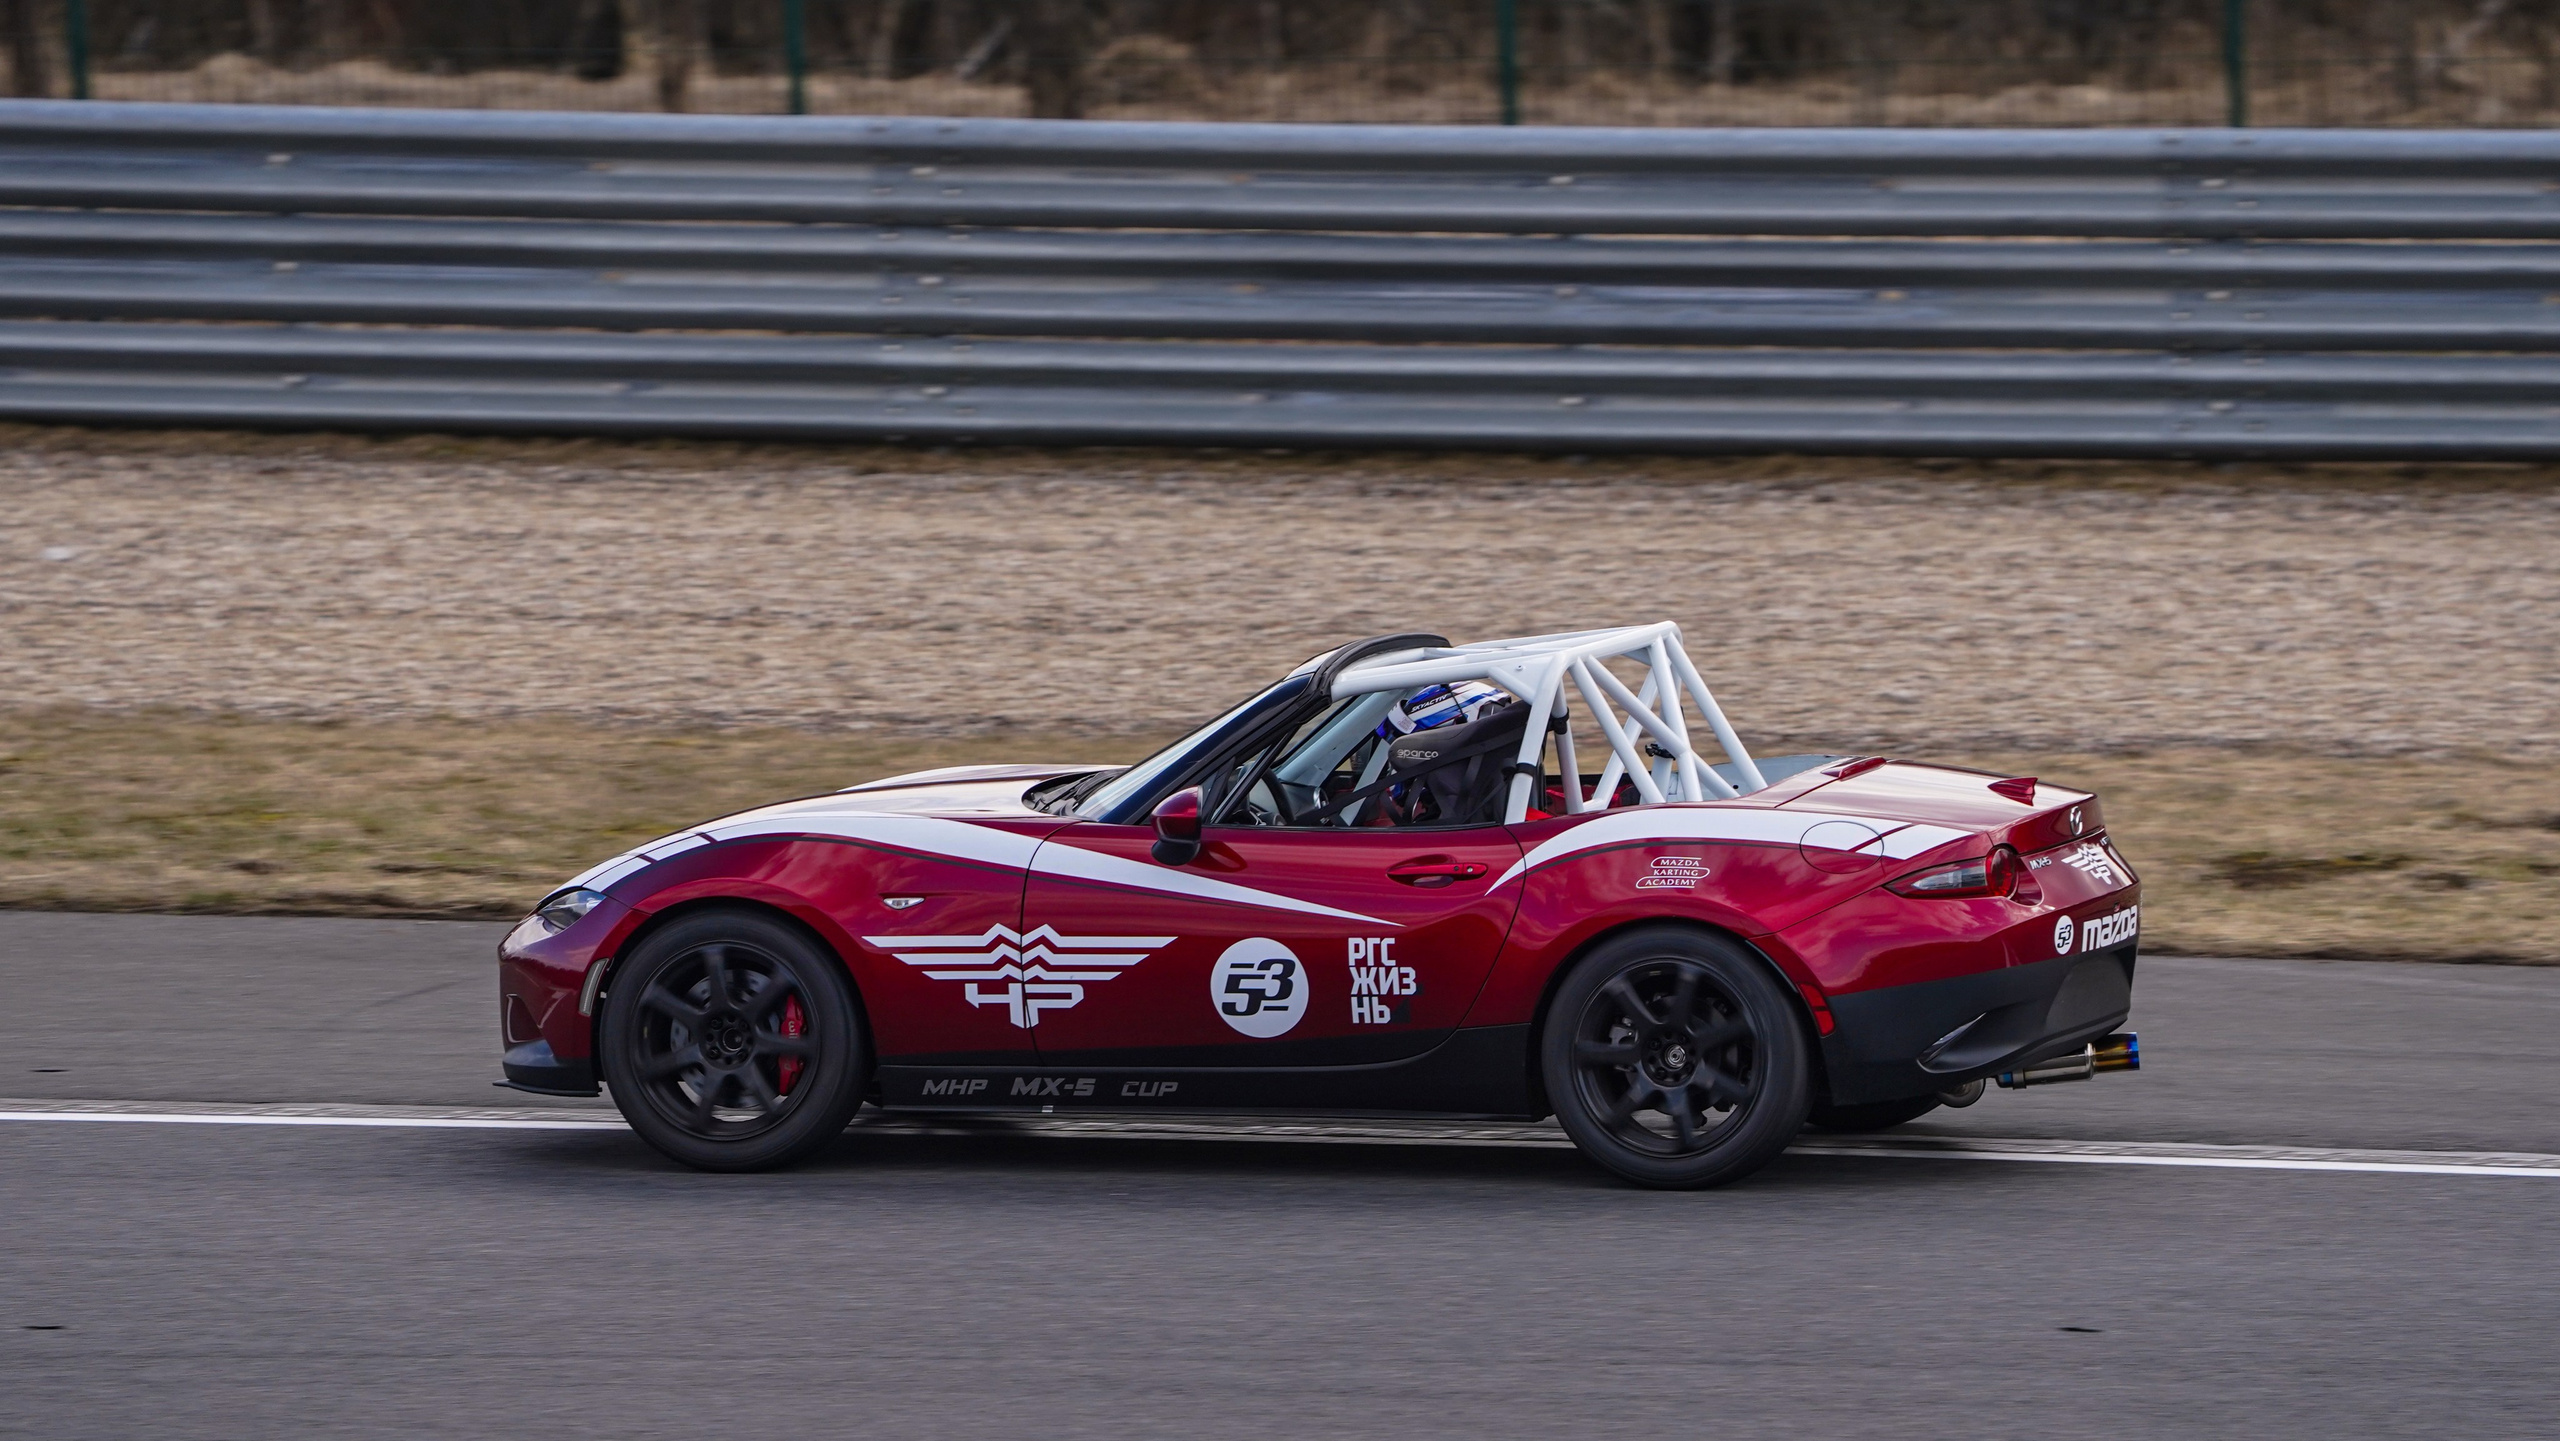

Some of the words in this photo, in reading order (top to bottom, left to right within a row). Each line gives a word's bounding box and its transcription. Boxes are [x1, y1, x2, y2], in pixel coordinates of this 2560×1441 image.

[1410, 694, 1449, 713] SKYACTIV
[1397, 749, 1439, 759] sparco
[1660, 859, 1700, 867] MAZDA
[2029, 856, 2053, 870] MX-5
[1645, 878, 1697, 886] ACADEMY
[2057, 924, 2072, 949] 53
[2081, 904, 2138, 952] mazda
[1348, 937, 1397, 967] РГС
[1221, 958, 1297, 1016] 53
[1349, 966, 1417, 996] ЖИЗ
[1351, 996, 1392, 1024] НЬ
[921, 1079, 988, 1096] MHP
[1010, 1077, 1097, 1097] MX-5
[1121, 1081, 1179, 1097] CUP
